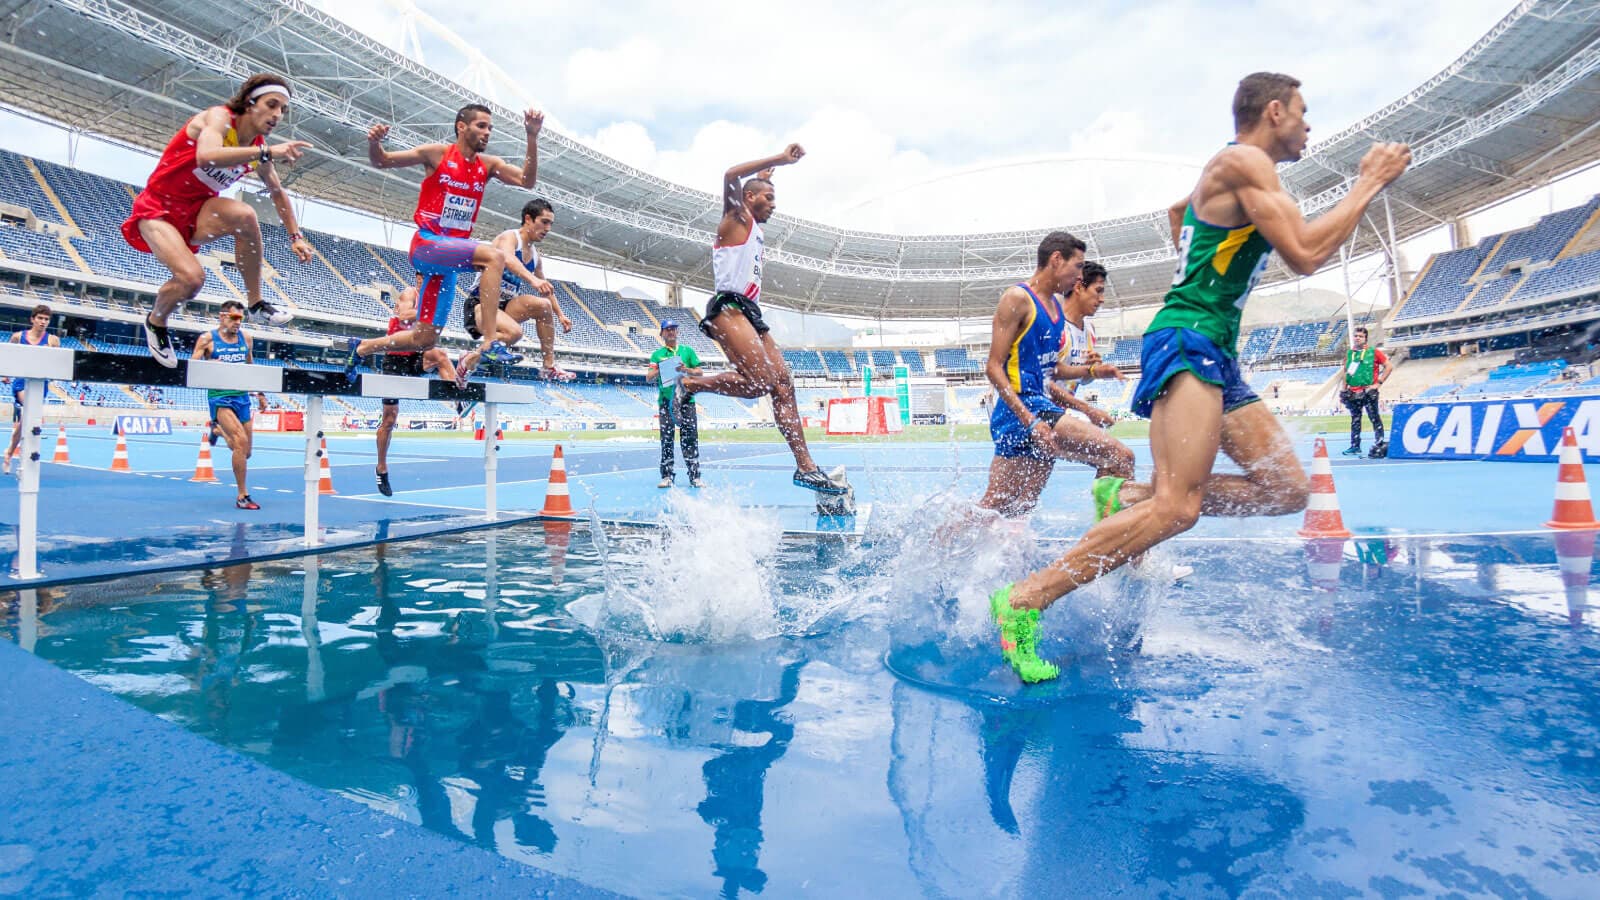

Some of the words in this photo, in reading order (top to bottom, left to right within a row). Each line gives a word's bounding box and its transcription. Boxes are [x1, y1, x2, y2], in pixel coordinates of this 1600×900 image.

[440, 174, 470, 190] Puerto
[122, 417, 170, 433] CAIXA
[1402, 400, 1600, 456] CAIXA
